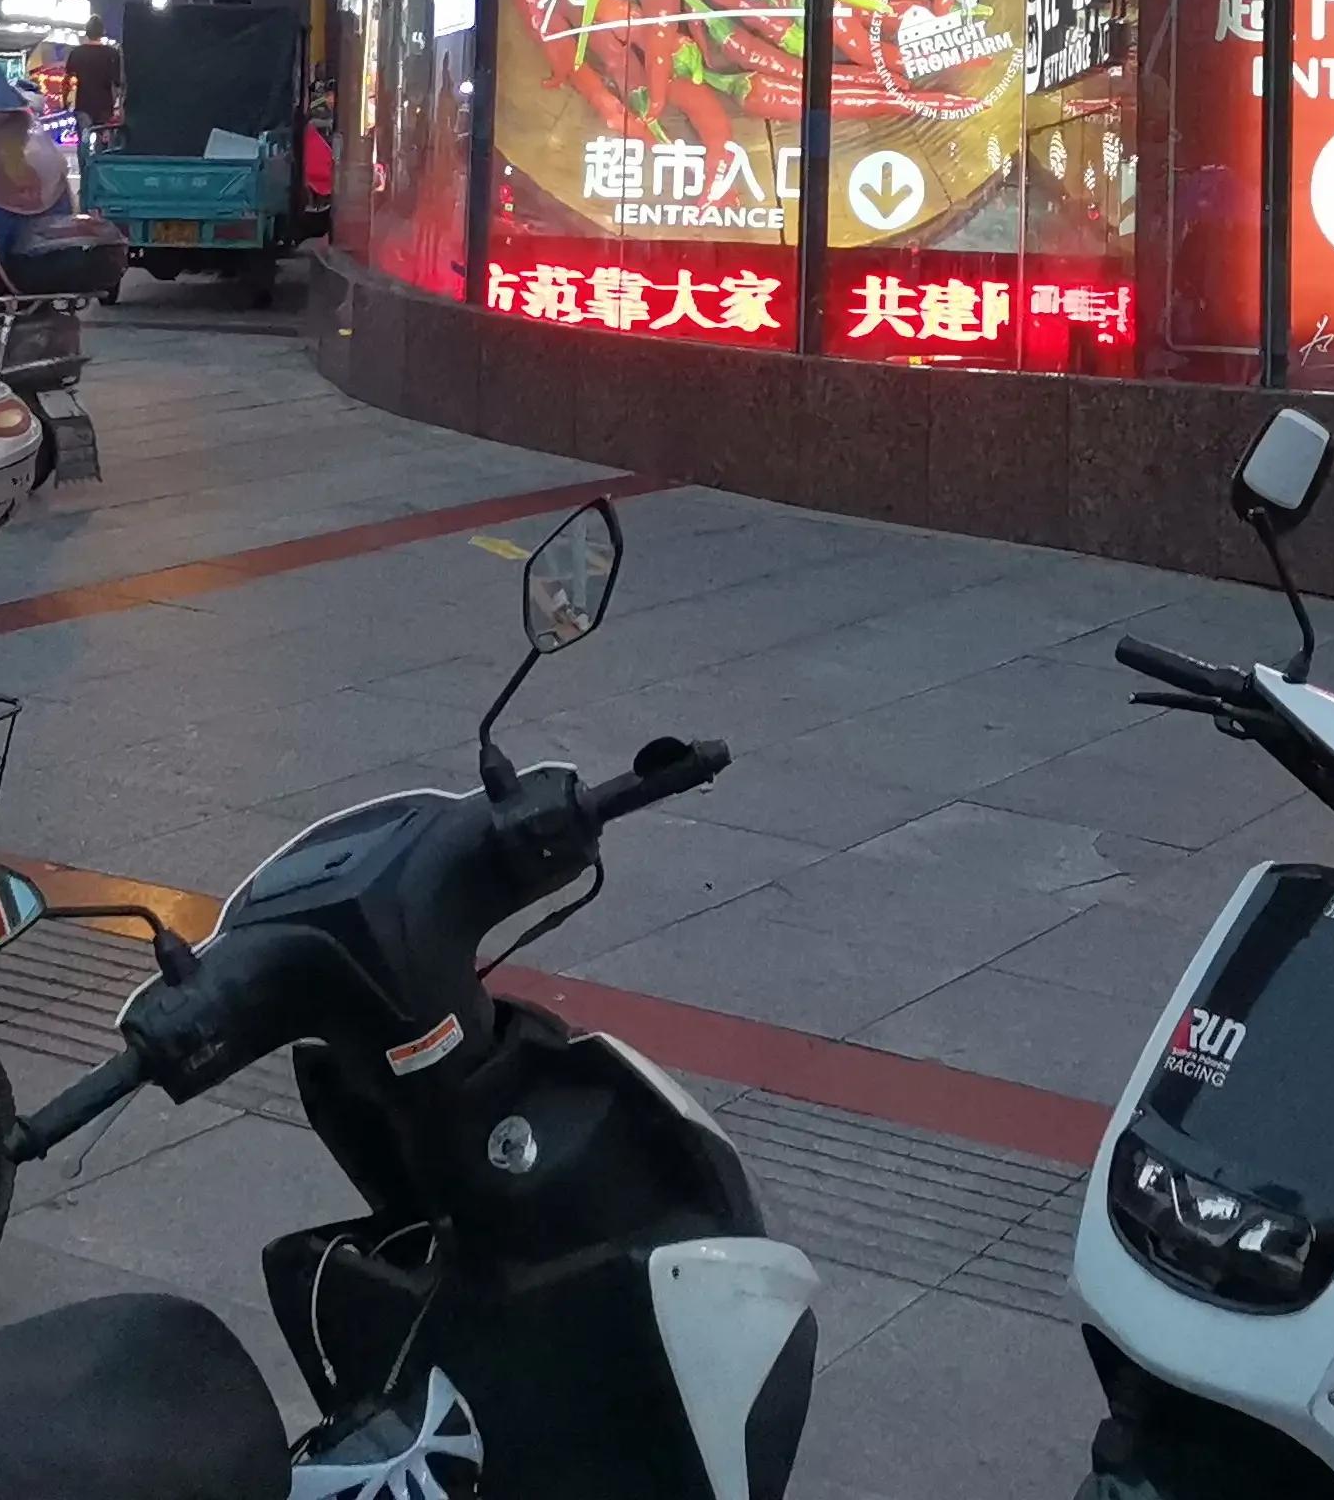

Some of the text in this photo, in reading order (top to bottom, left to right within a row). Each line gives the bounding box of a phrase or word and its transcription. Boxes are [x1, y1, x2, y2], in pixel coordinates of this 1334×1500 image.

[898, 20, 987, 64] STRAIGHT
[904, 31, 1014, 80] FROM FARM
[583, 135, 801, 201] 超市入口
[614, 203, 785, 229] ENTRANCE
[1163, 1056, 1227, 1089] RACING
